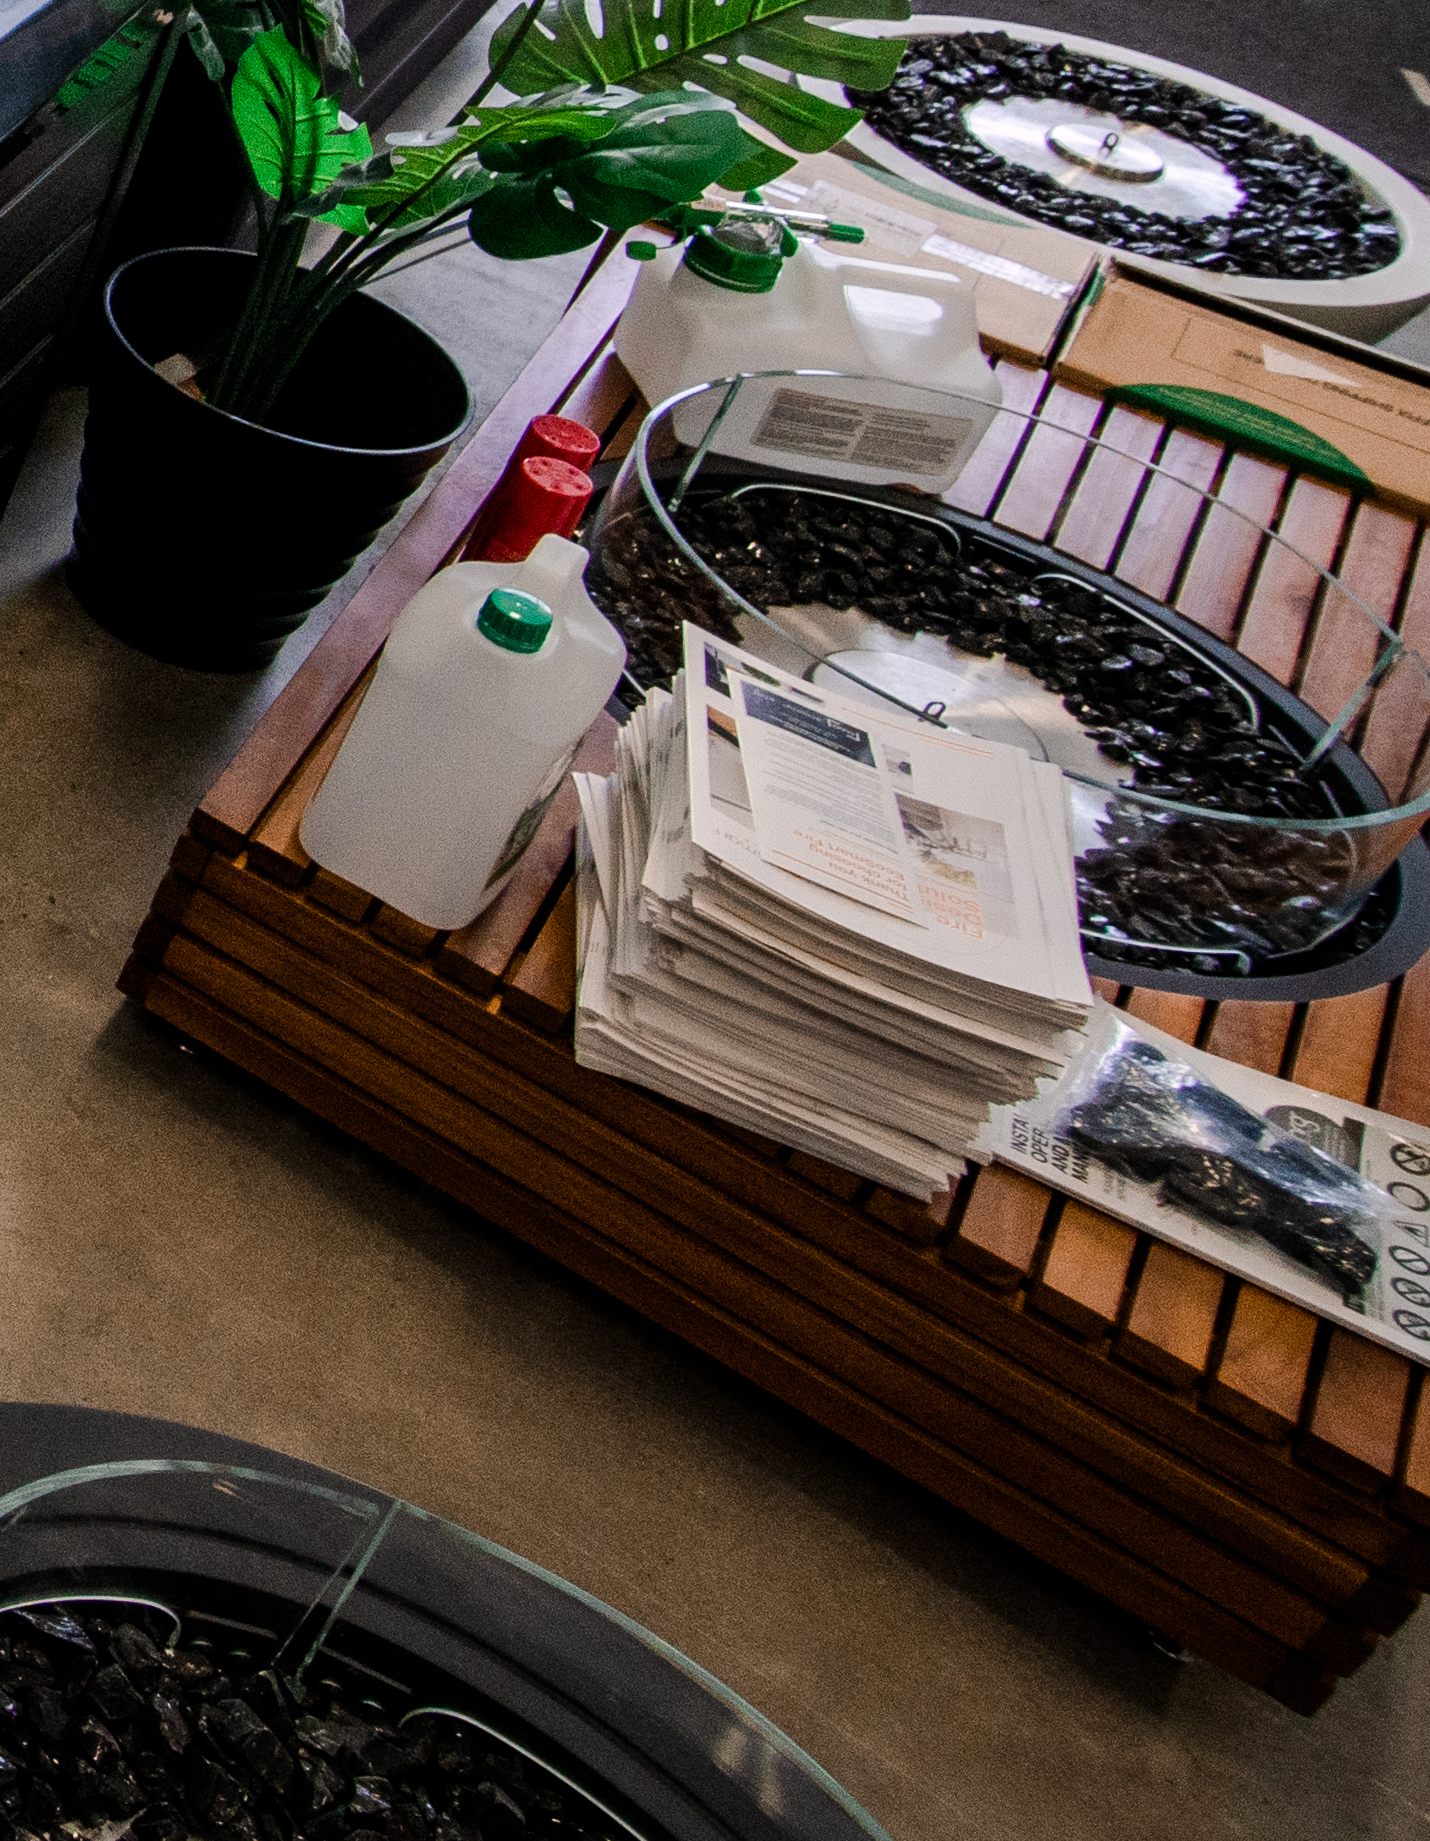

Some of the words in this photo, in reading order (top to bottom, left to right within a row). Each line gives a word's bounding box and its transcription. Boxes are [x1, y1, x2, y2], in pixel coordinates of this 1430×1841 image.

[809, 841, 881, 878] choosing
[827, 843, 906, 882] EcoSmart
[828, 861, 858, 879] you
[861, 875, 910, 902] Thank
[886, 877, 908, 893] for
[920, 897, 983, 927] Desi
[937, 916, 984, 940] Fire
[1050, 1143, 1070, 1175] AND
